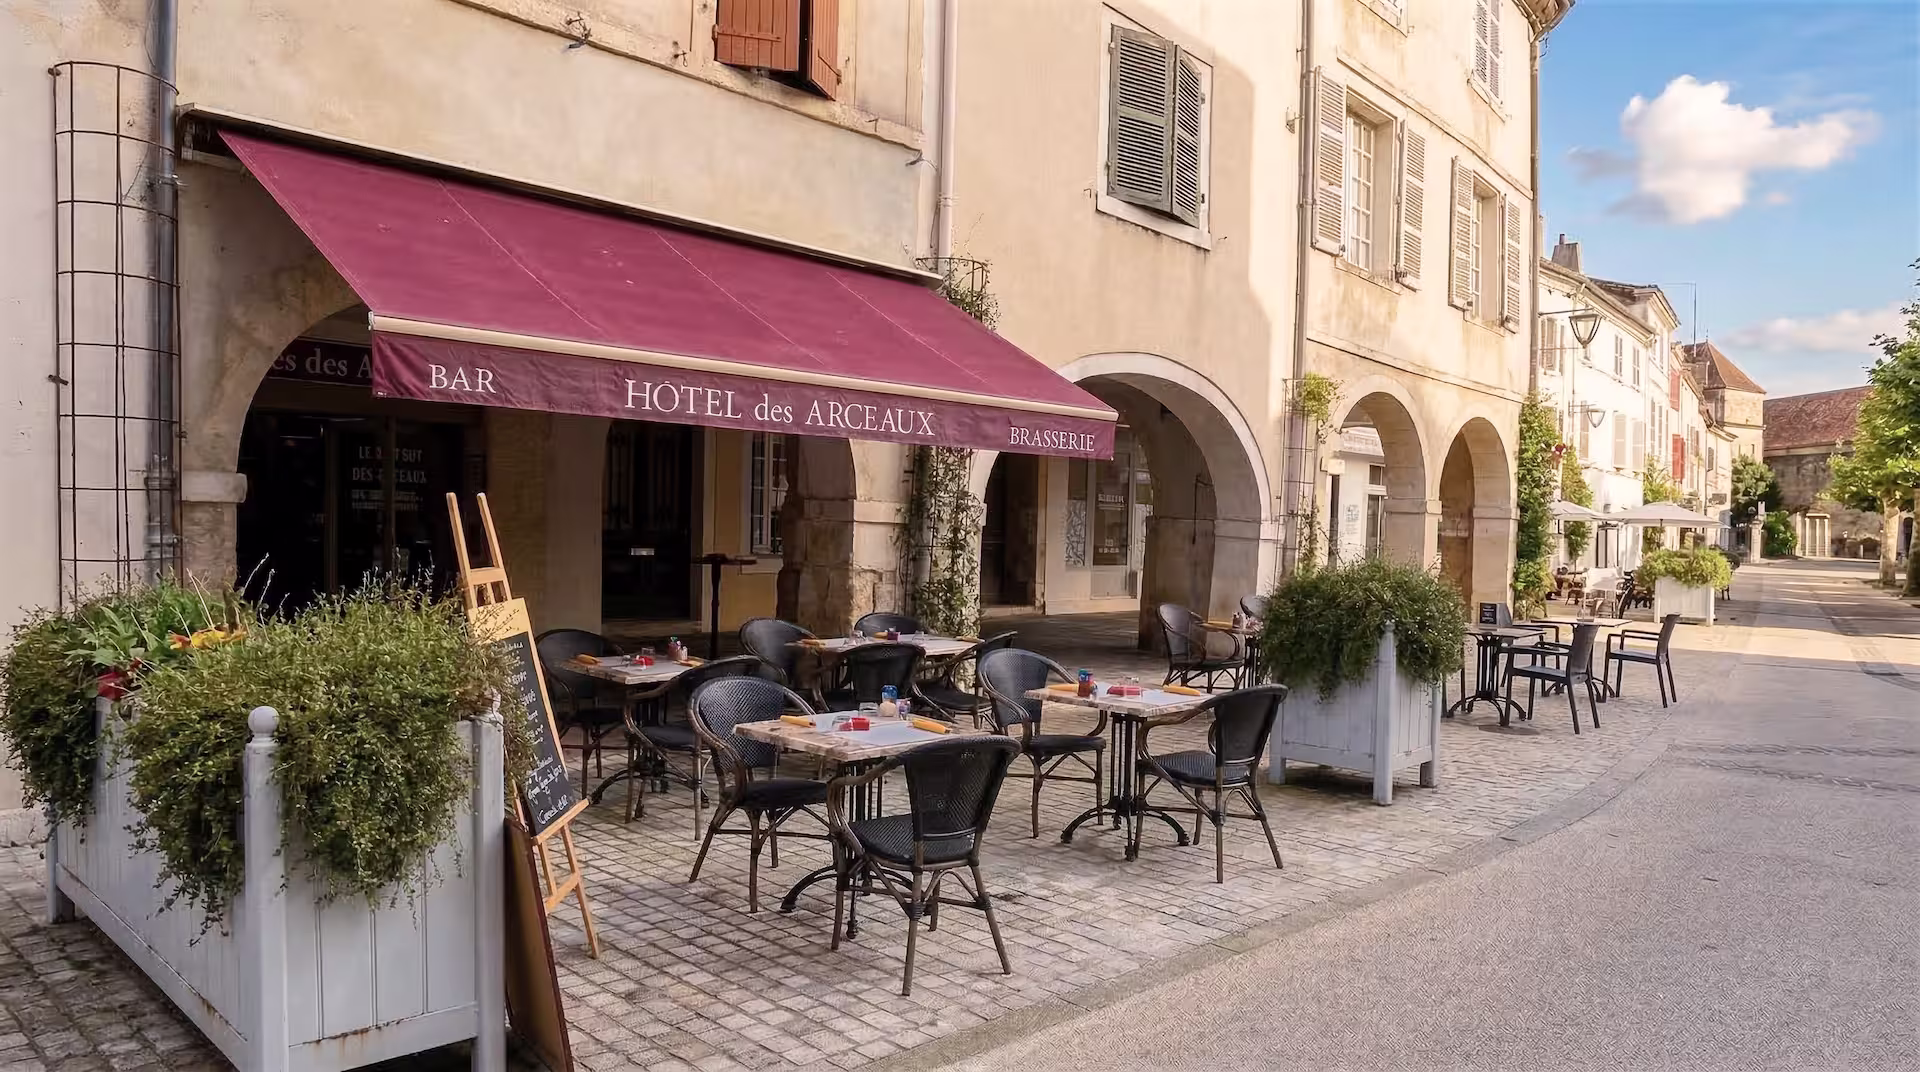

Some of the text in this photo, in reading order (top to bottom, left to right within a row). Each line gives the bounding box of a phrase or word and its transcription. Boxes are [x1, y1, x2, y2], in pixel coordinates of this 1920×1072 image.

[272, 347, 373, 379] es des A
[428, 363, 497, 394] BAR
[624, 378, 936, 436] HÔTEL des ARCEAUX
[359, 445, 373, 460] LE
[1009, 425, 1095, 452] BRASSERIE
[352, 466, 374, 482] DES
